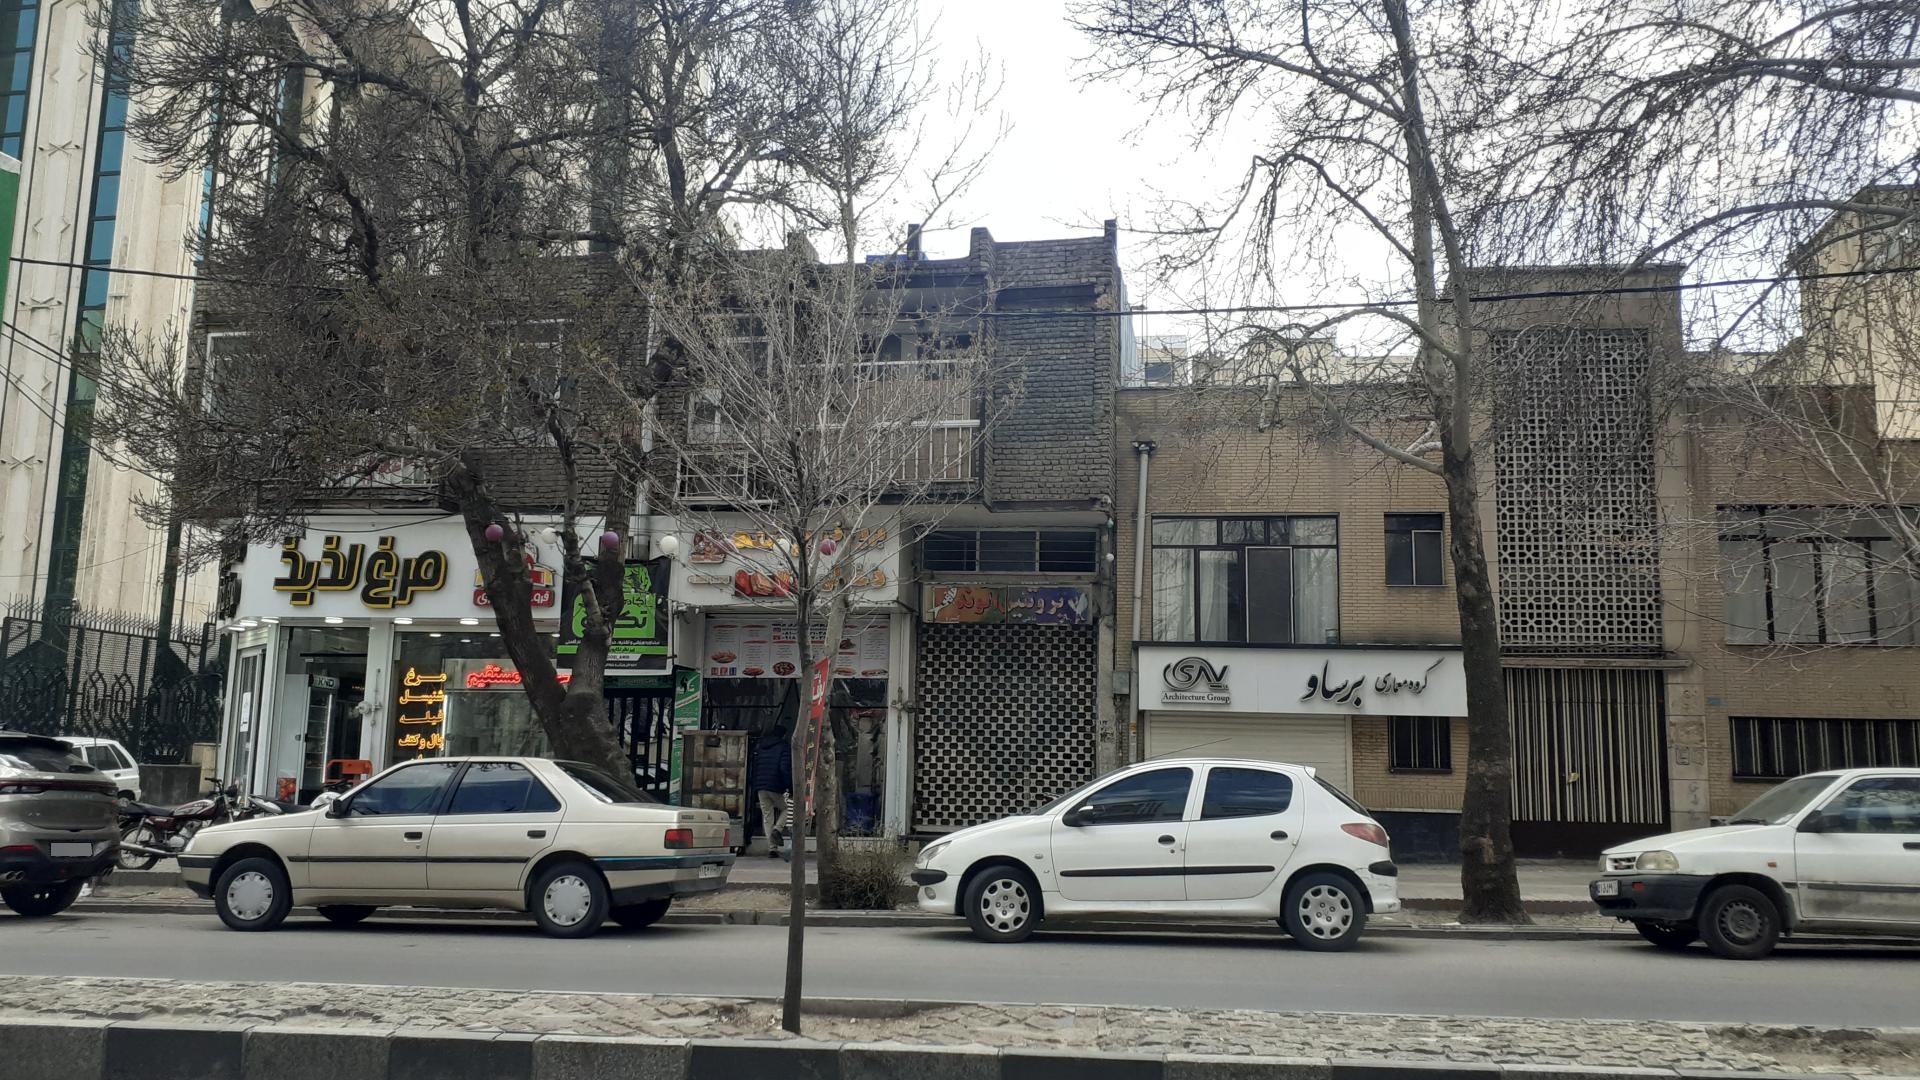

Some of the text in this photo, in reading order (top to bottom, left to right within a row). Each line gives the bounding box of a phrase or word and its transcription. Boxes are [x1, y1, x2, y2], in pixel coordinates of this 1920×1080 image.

[272, 535, 366, 606] لذیذ
[360, 535, 449, 609] مرغ
[404, 667, 448, 687] مرغ
[466, 664, 522, 689] مستقیم
[1300, 659, 1366, 707] برساو
[1374, 672, 1408, 694] معماری
[398, 688, 445, 705] شنیسل
[1163, 692, 1230, 703] Architecture Group
[398, 709, 445, 726] فیله
[418, 737, 427, 750] و
